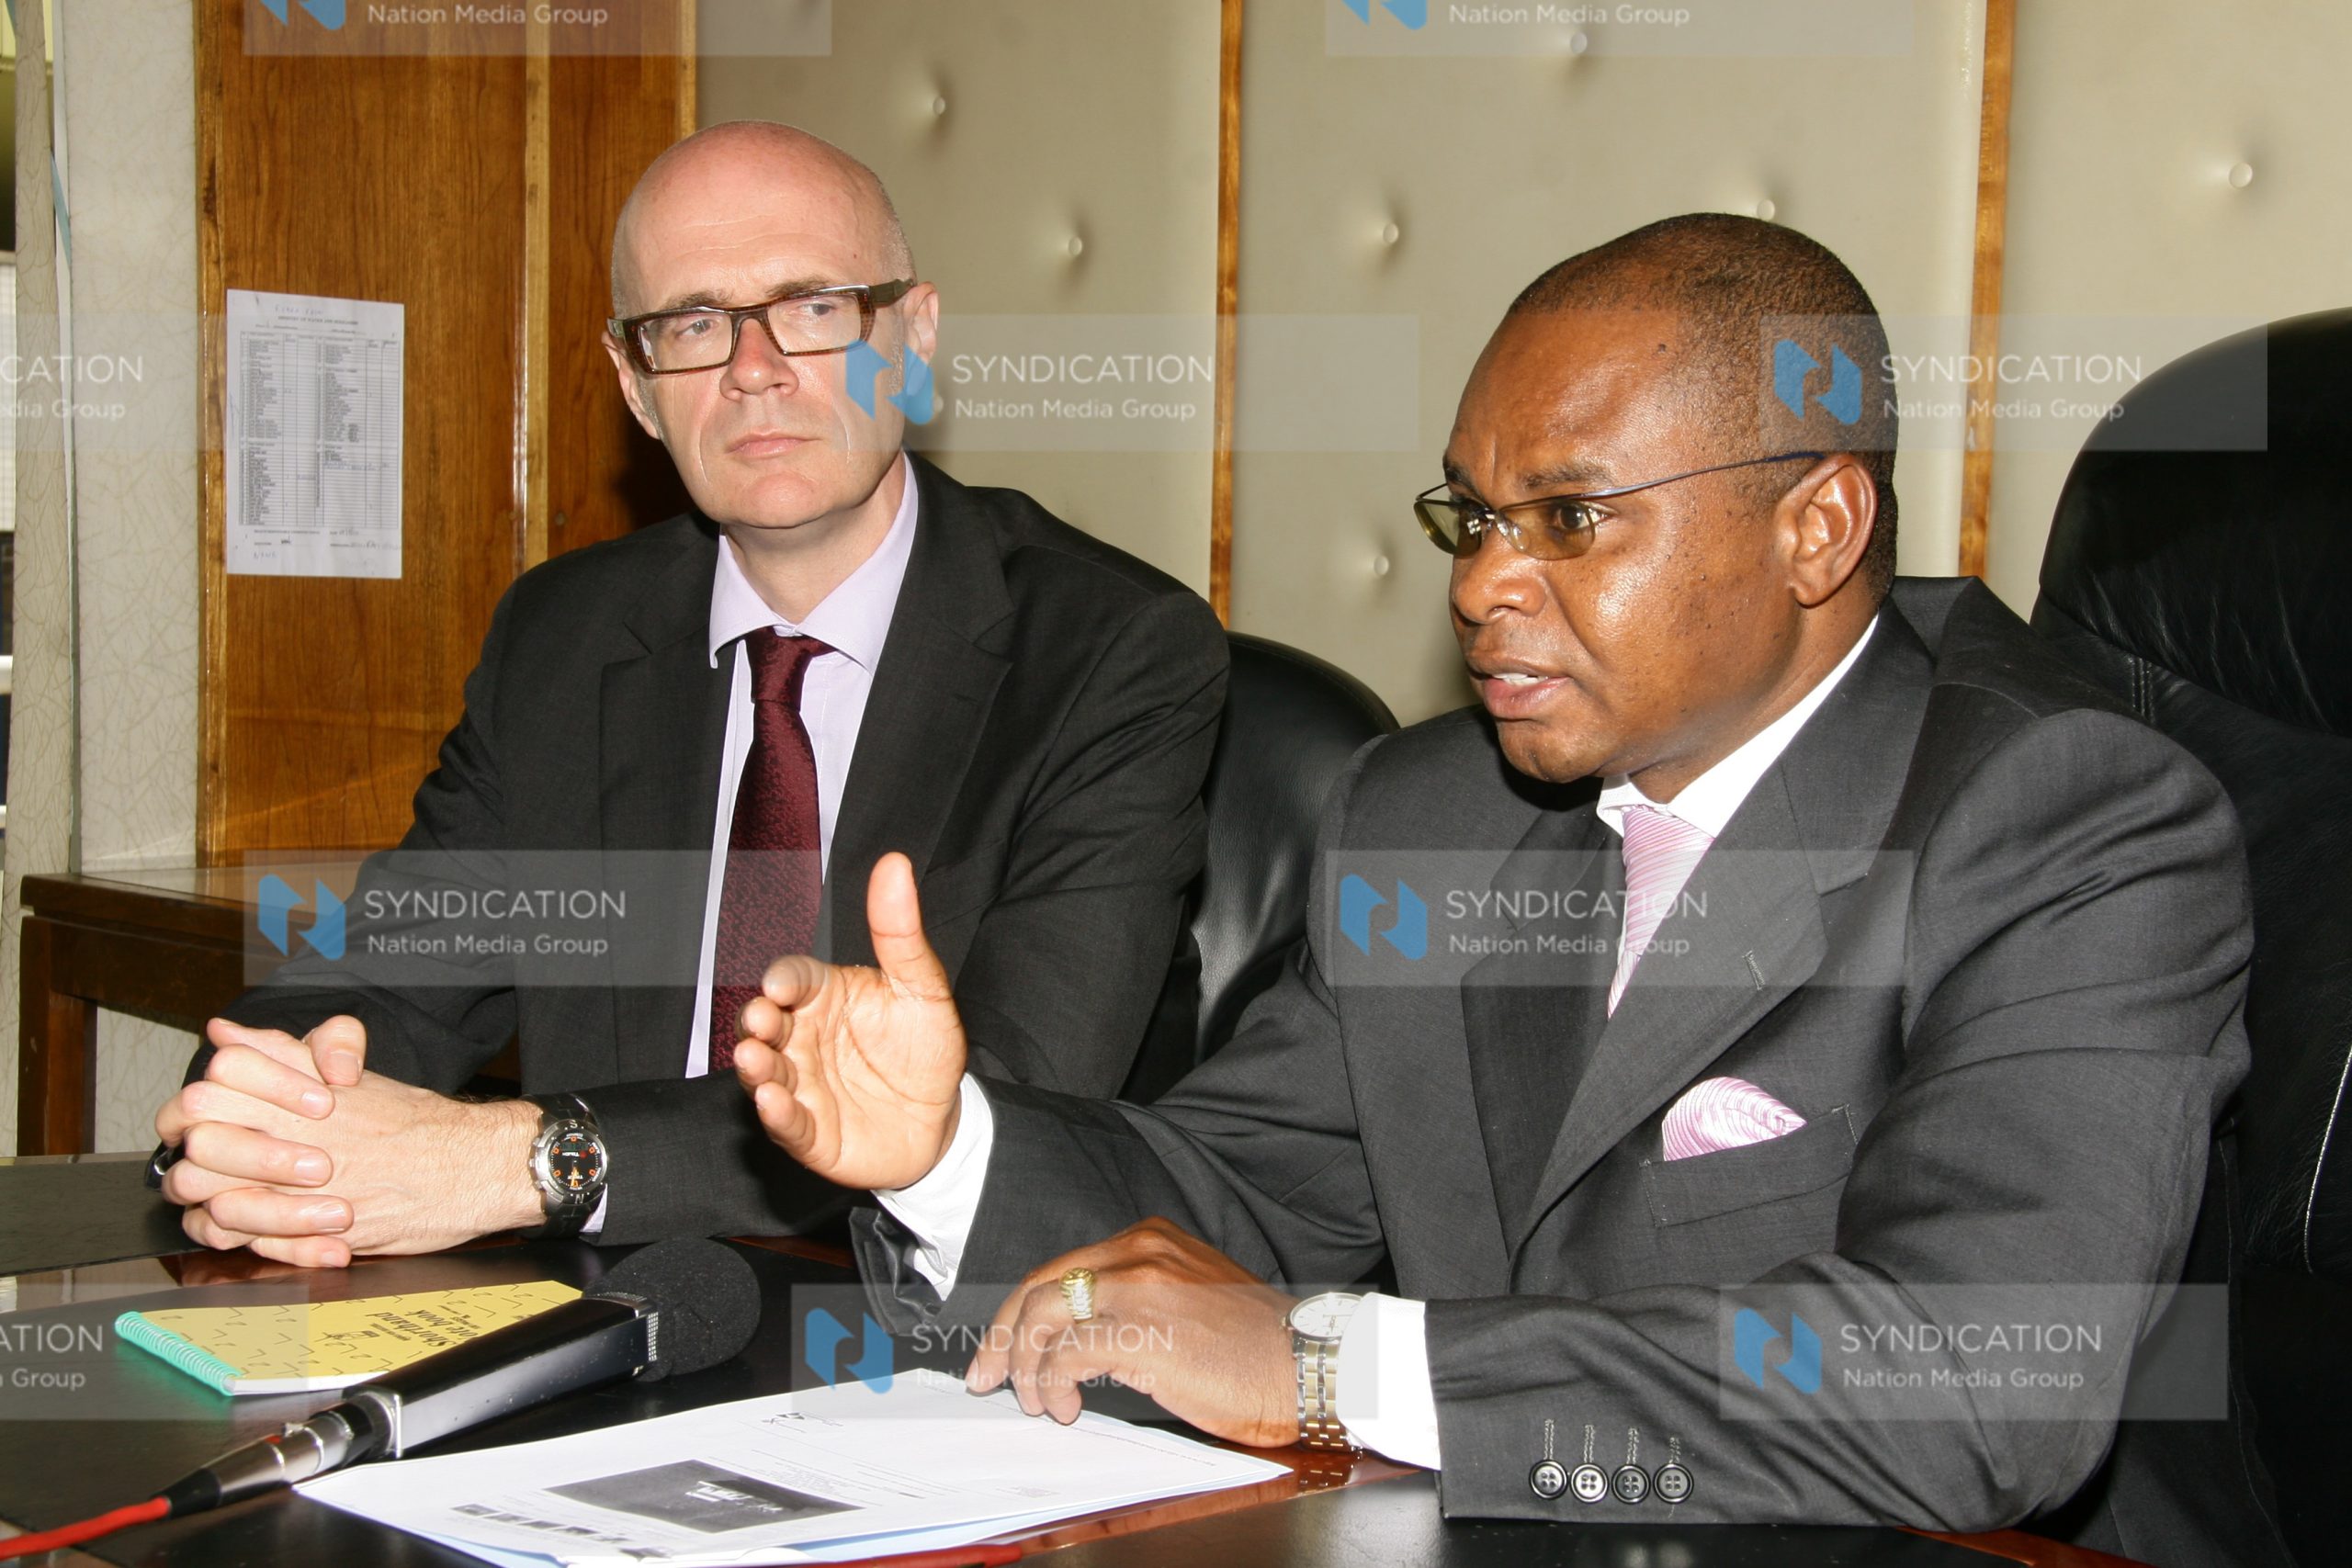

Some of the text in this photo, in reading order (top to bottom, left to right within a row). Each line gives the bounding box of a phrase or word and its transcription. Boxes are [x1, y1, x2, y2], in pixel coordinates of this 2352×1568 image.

[404, 1309, 454, 1327] book
[365, 1312, 458, 1348] Shorthand
[444, 1326, 479, 1340] ote
